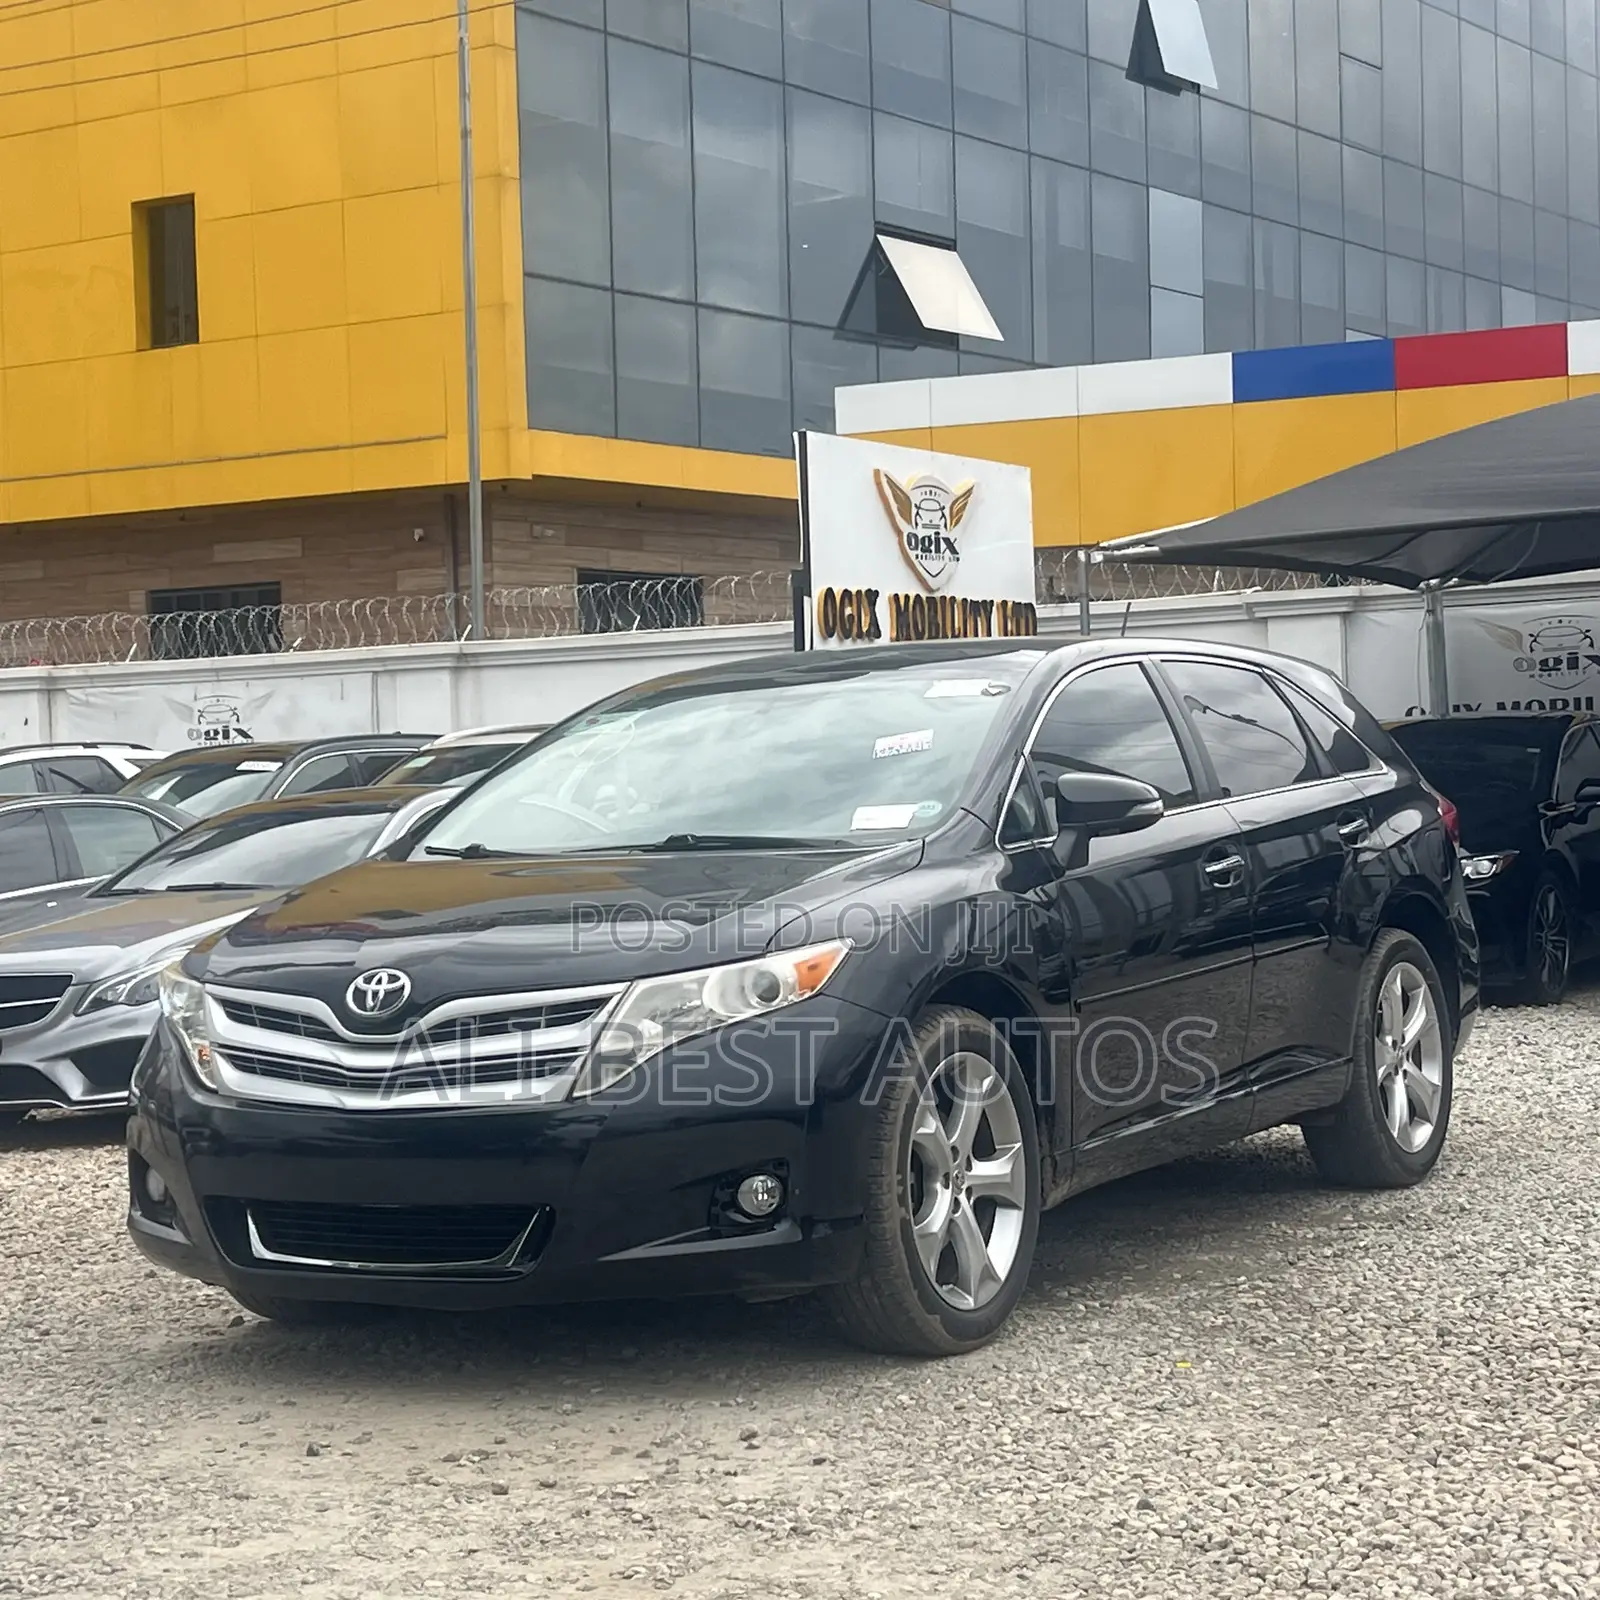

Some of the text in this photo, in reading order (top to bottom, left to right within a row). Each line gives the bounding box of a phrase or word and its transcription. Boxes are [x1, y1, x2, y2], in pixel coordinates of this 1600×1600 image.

[906, 531, 959, 555] ogix
[818, 587, 881, 640] OGIX
[888, 593, 994, 642] MOBILITY
[187, 725, 254, 741] ogix
